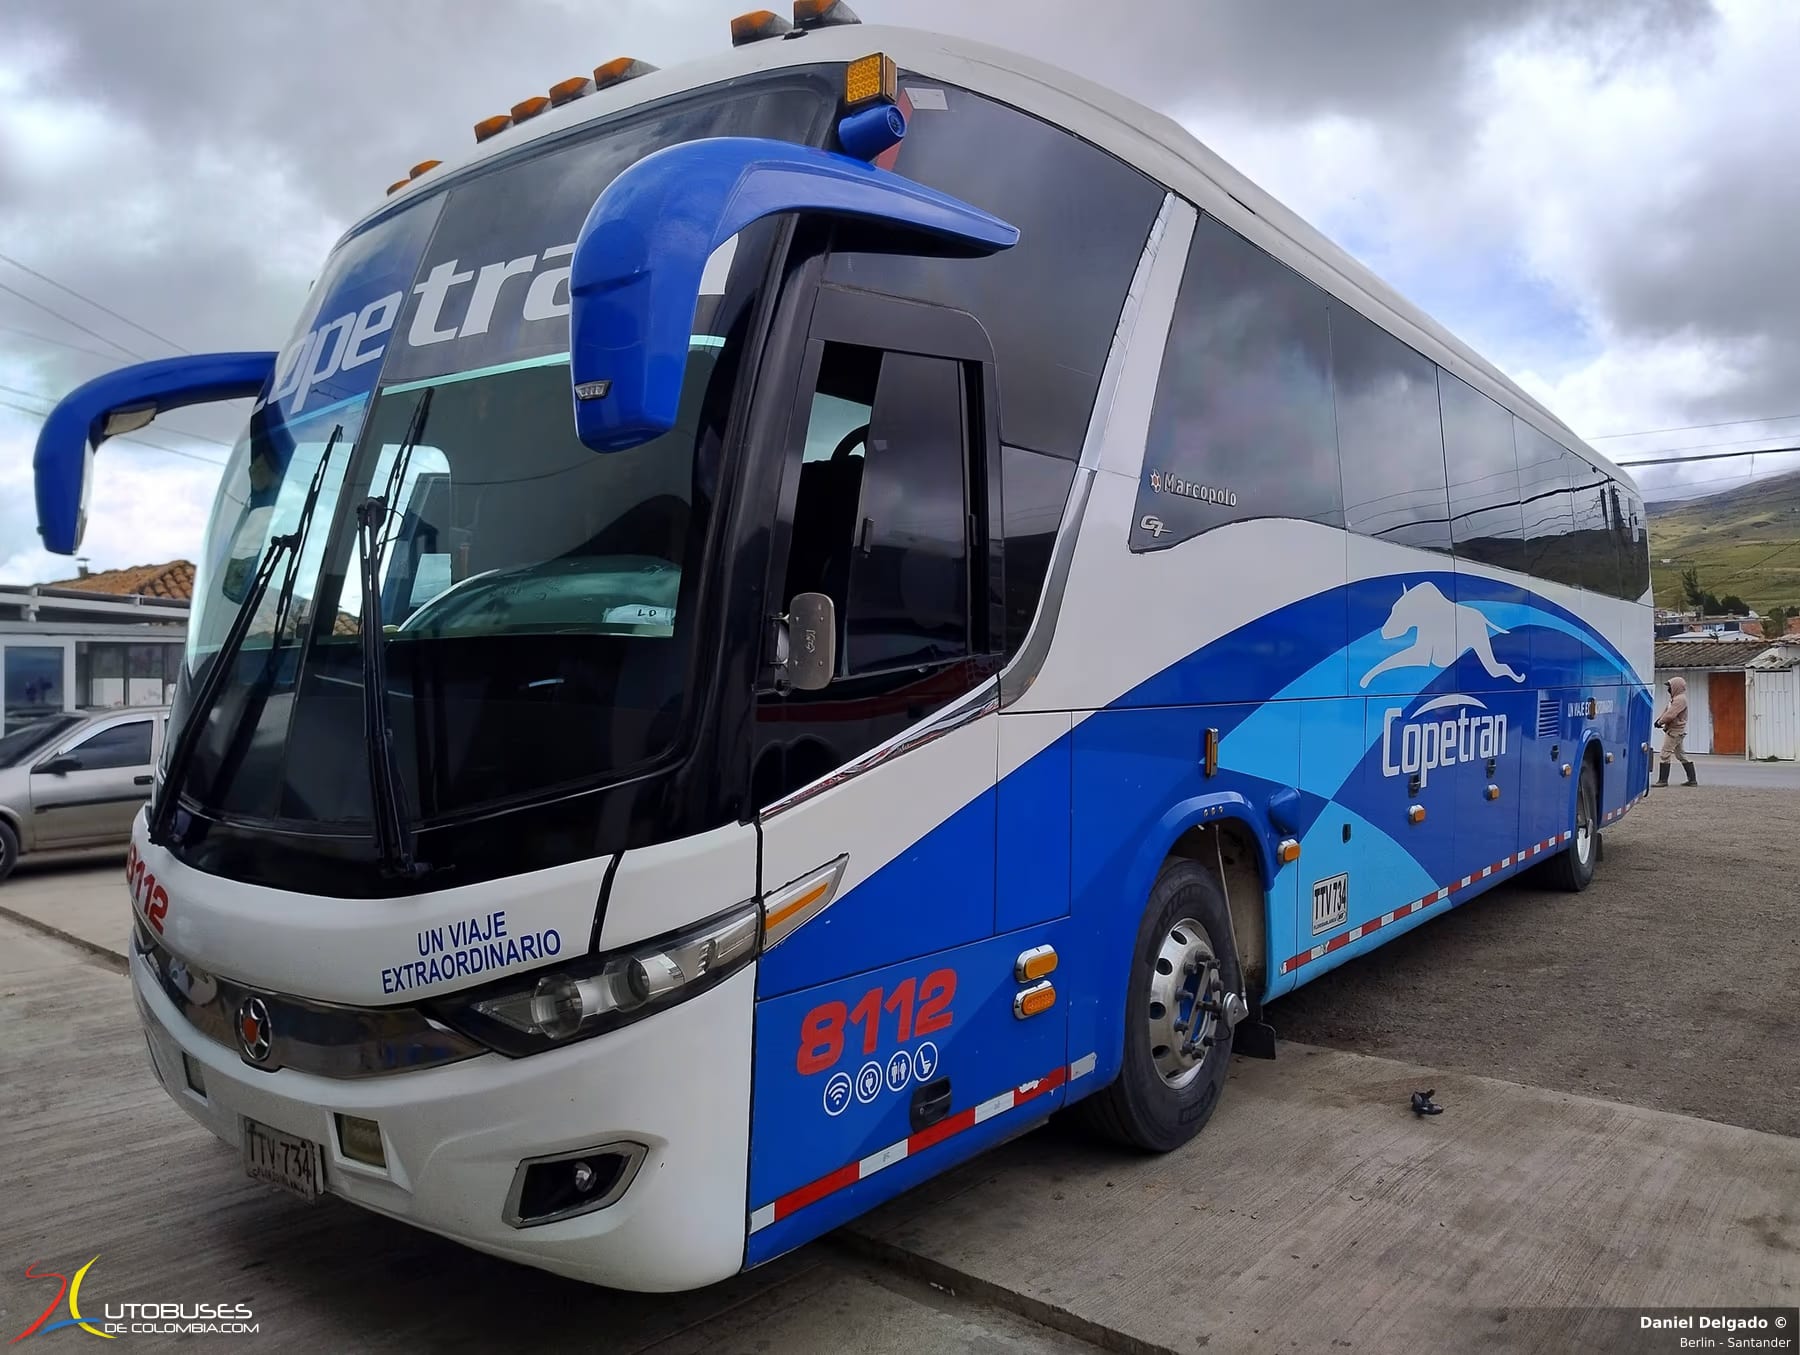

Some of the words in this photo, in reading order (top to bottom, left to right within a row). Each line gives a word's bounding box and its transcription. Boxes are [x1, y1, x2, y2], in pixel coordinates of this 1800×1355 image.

[1163, 472, 1238, 507] Marcopolo
[1382, 706, 1507, 789] Copetran
[126, 842, 169, 936] 8112
[381, 928, 562, 995] EXTRAORDINARIO
[417, 927, 444, 957] UN
[448, 910, 508, 948] VIAJE
[796, 968, 958, 1076] 8112
